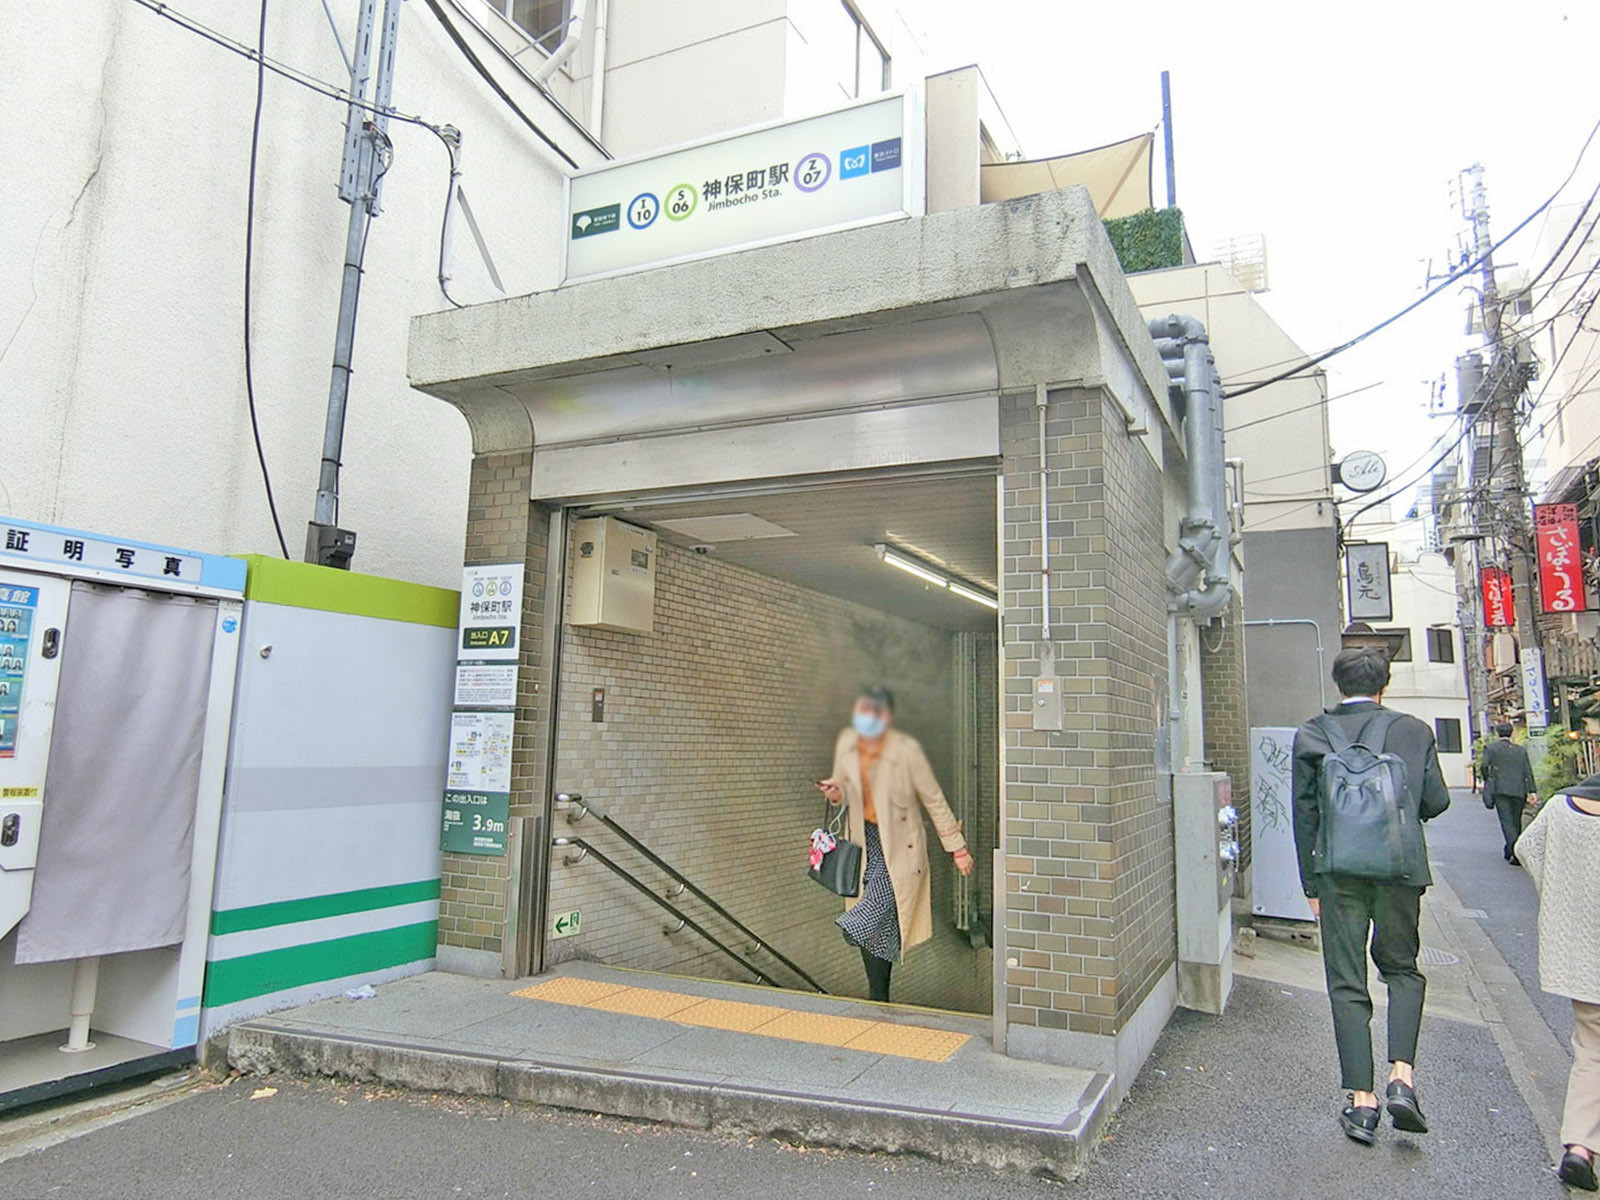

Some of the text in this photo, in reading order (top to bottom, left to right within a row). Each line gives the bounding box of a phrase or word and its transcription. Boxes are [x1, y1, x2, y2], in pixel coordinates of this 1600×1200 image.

[808, 159, 817, 171] Z
[702, 163, 790, 201] 神保町駅
[803, 170, 822, 185] 07
[677, 190, 685, 201] S
[708, 188, 783, 212] Jimbocho Sta.
[641, 199, 646, 209] I
[672, 201, 689, 214] 06
[637, 210, 652, 222] 10
[6, 529, 183, 577] 証明写真
[489, 630, 509, 646] A7
[445, 793, 488, 805] この出入口は
[472, 814, 504, 832] 3.9m
